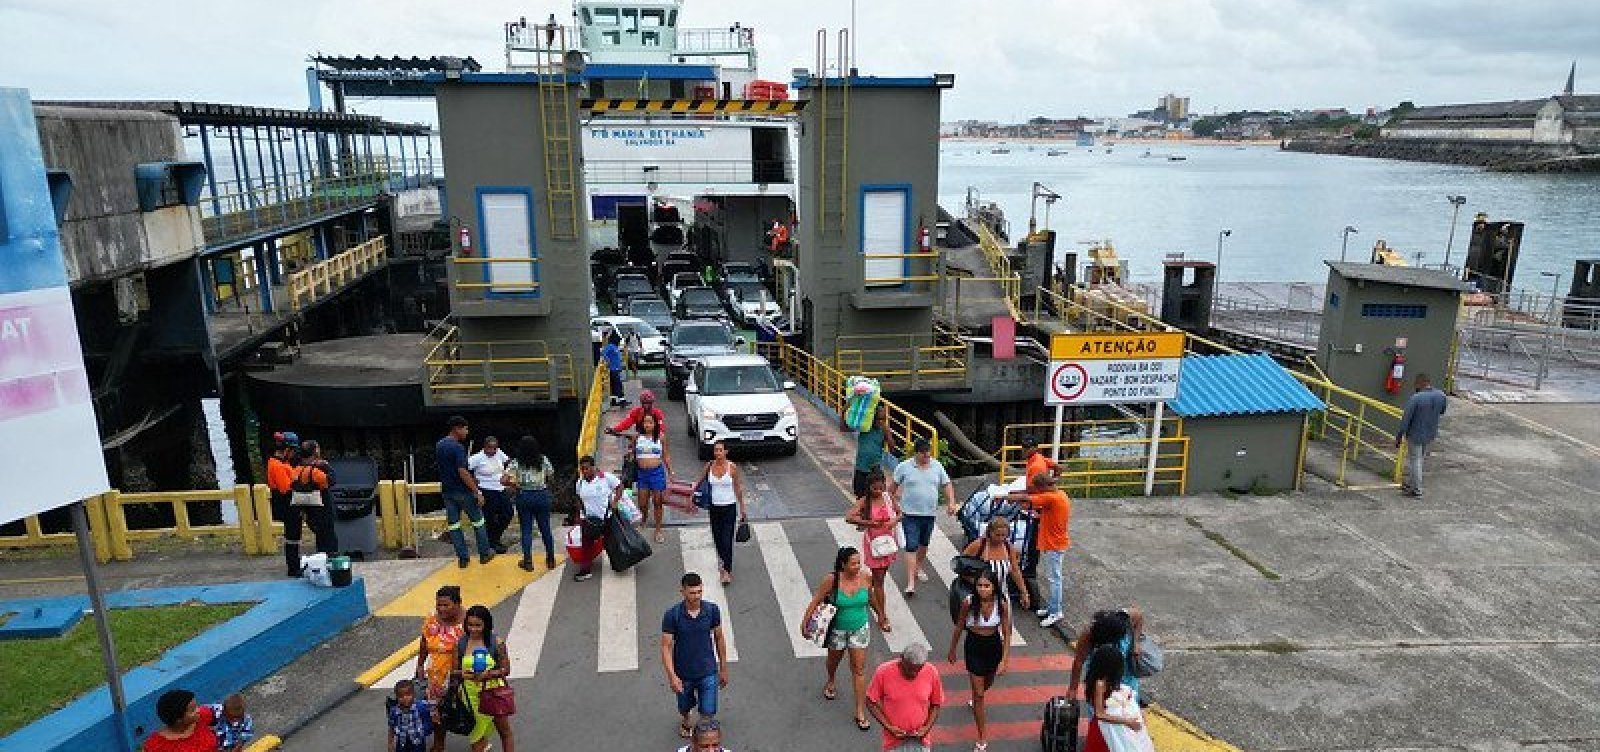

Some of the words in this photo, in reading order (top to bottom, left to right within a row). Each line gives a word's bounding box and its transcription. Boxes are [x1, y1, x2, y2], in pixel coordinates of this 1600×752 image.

[613, 129, 644, 138] MARIA
[650, 129, 704, 138] BETHANIA
[1080, 338, 1157, 355] ATENÇÃO
[1107, 363, 1137, 372] RODOVIA
[1140, 362, 1149, 371] BA
[1124, 375, 1138, 384] BOM
[1141, 373, 1177, 384] DESPACHO
[1103, 387, 1126, 396] PONTE
[1128, 387, 1138, 396] DO
